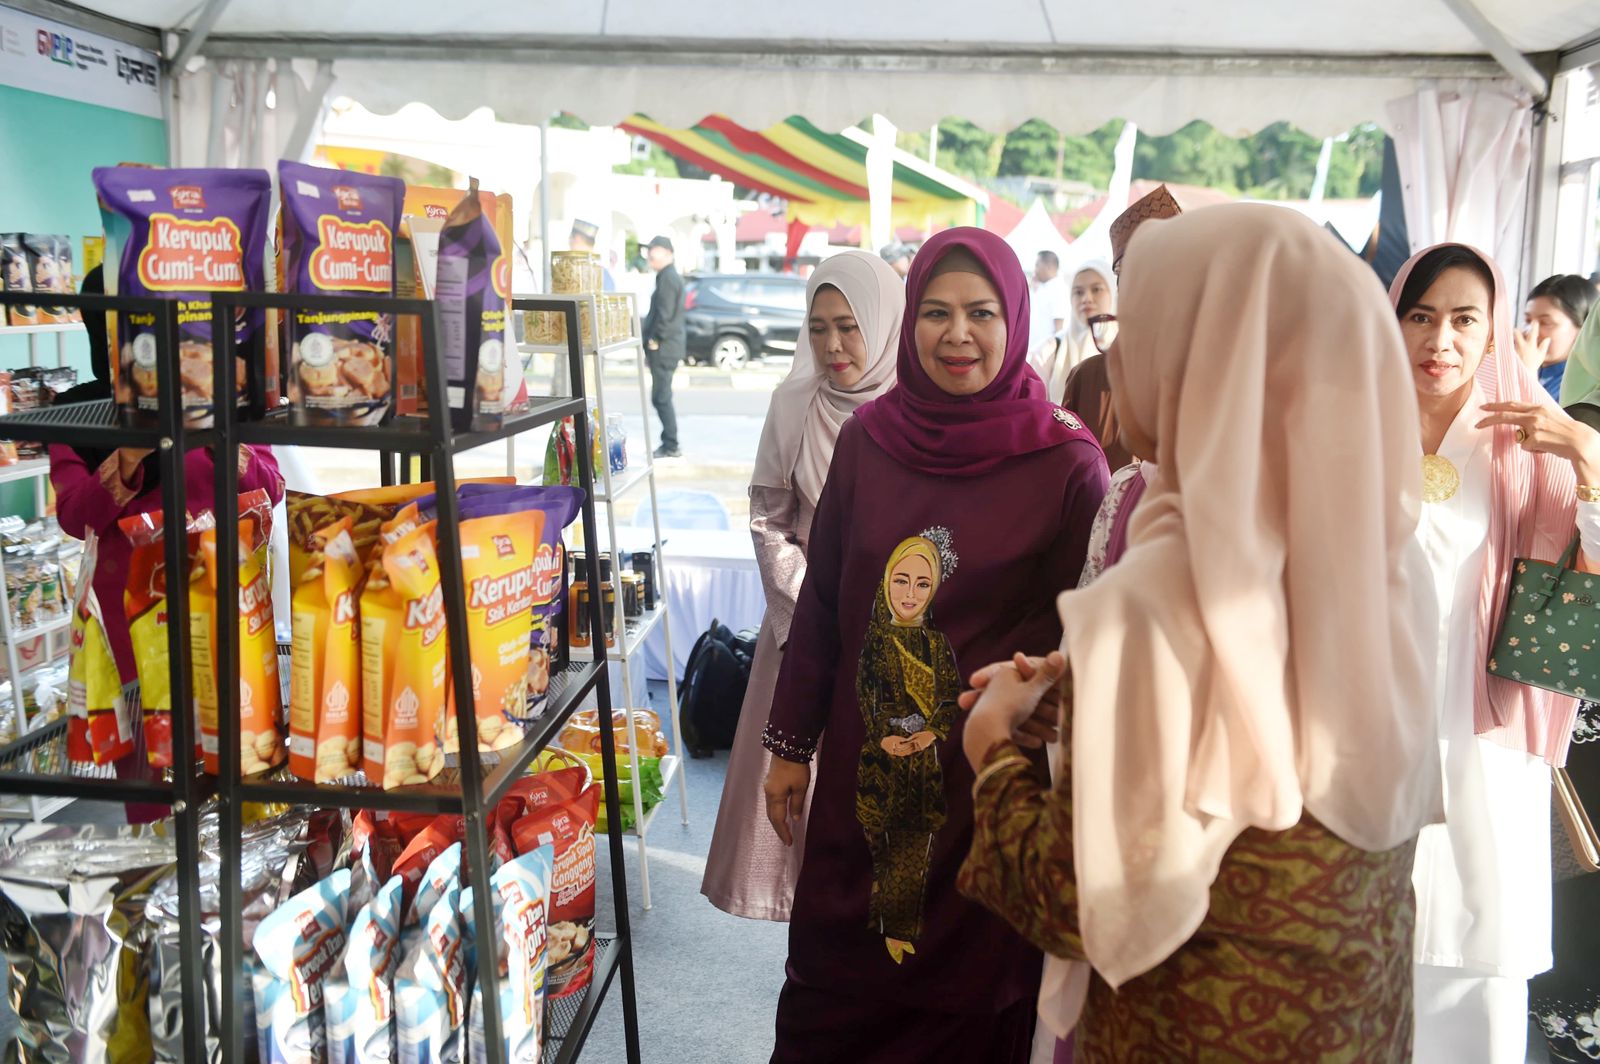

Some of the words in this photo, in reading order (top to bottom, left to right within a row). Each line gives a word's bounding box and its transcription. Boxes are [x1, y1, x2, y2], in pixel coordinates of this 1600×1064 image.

[157, 223, 233, 255] Kerupuk
[326, 223, 387, 256] Kerupuk
[529, 791, 548, 802] Kyra
